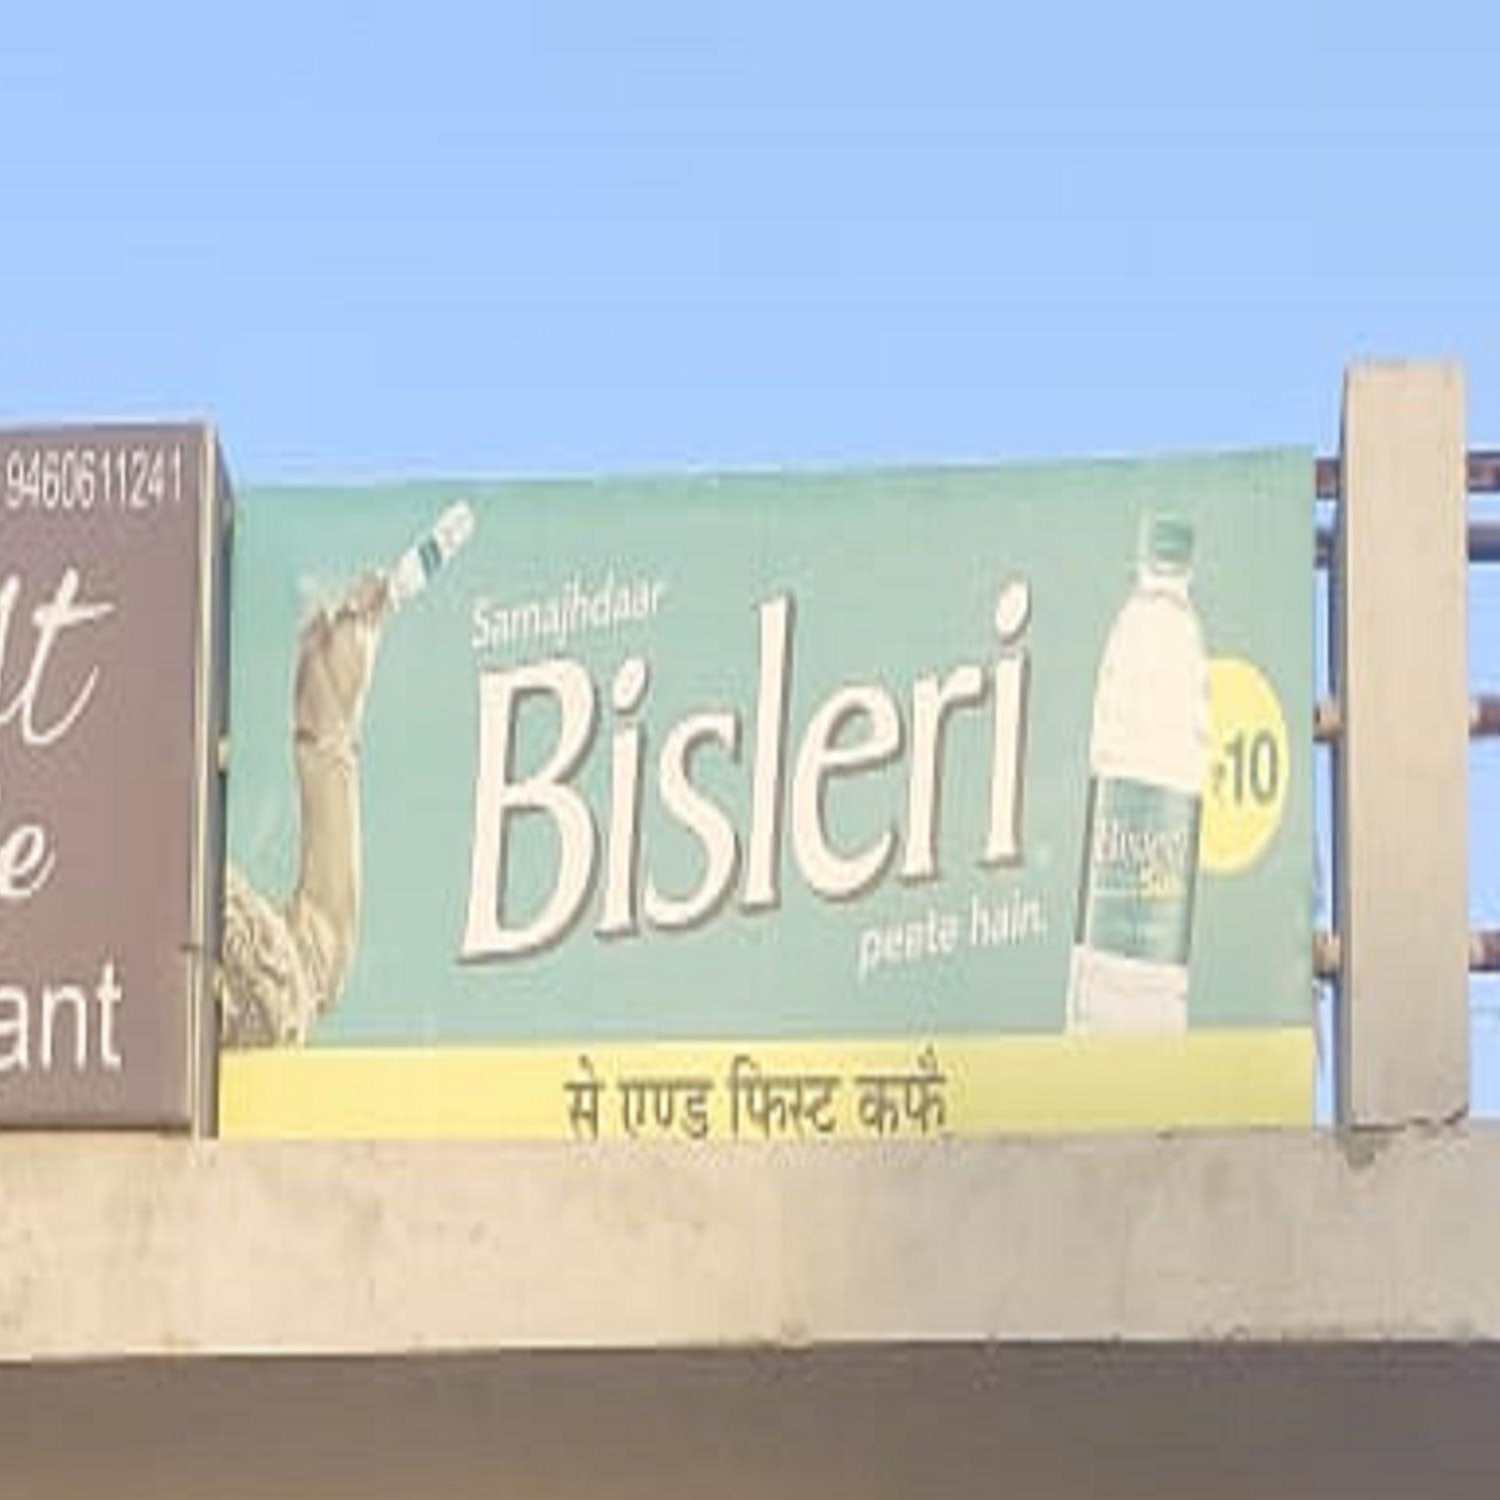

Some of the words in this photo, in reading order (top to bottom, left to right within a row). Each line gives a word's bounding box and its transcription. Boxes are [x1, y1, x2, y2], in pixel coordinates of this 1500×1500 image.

[6, 444, 182, 510] 9460611241
[470, 571, 667, 650] Samajhdaar
[457, 580, 1034, 962] Bisleri
